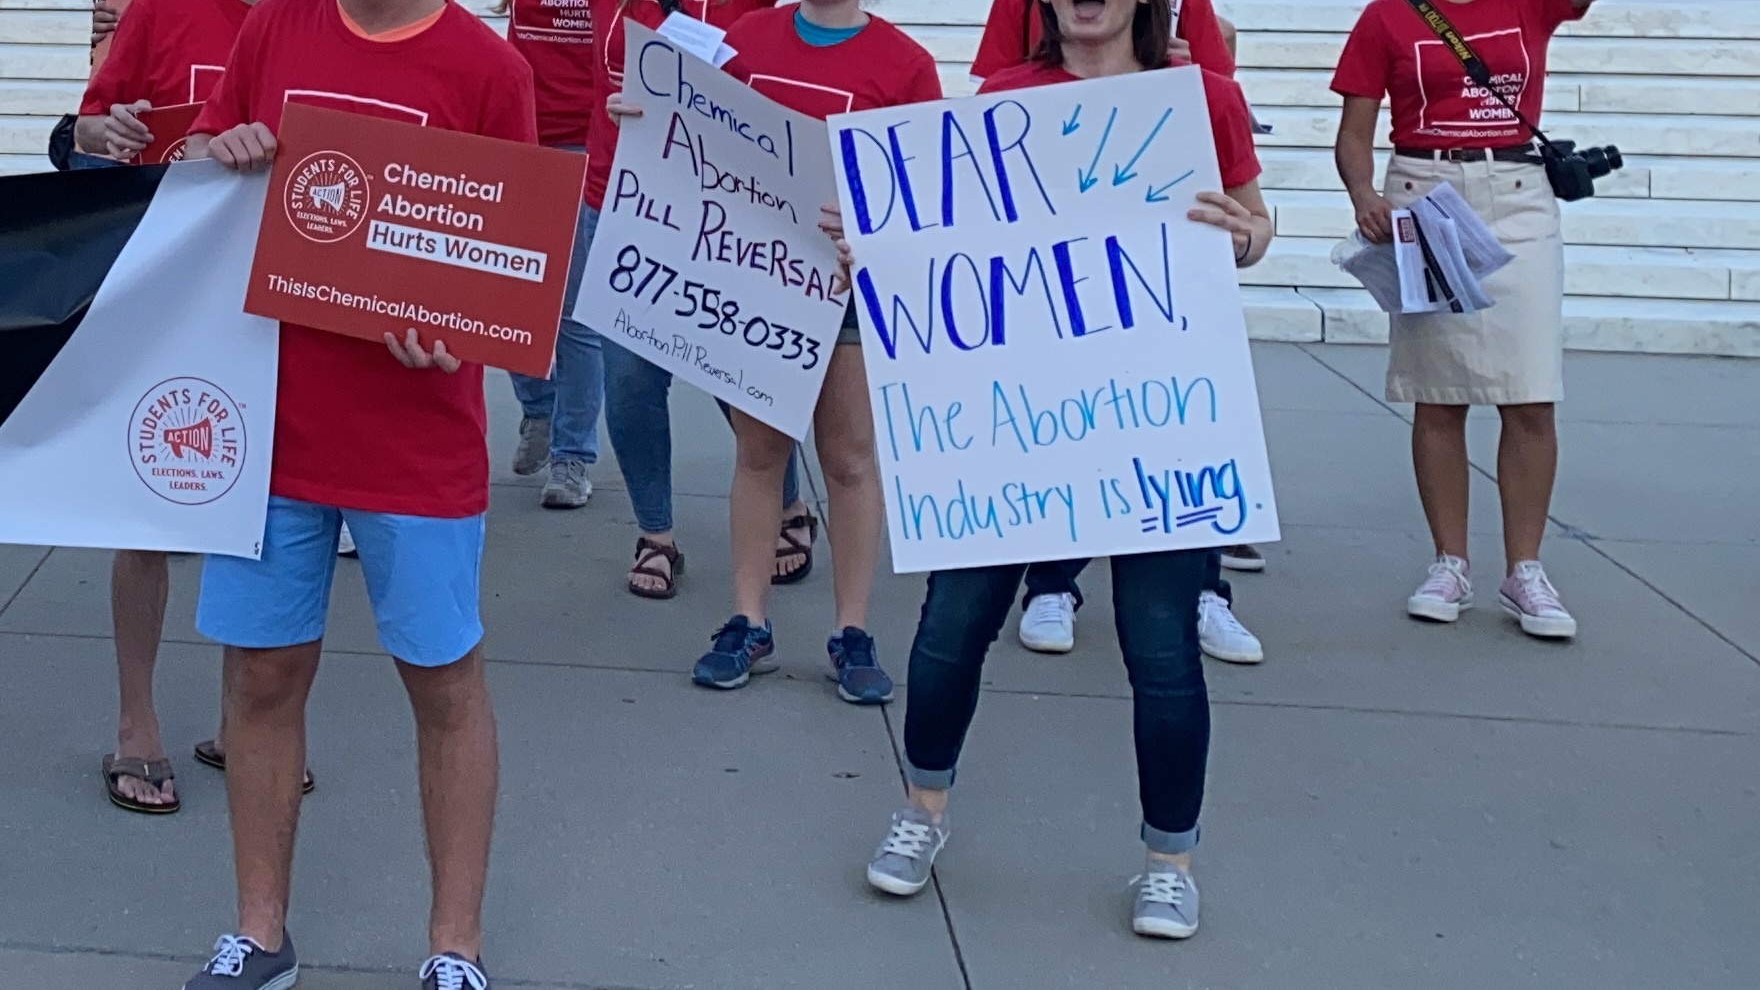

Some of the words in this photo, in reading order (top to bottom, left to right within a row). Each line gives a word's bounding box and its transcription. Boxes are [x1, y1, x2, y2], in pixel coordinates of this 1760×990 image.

[552, 17, 593, 29] WOMEN
[1463, 73, 1524, 87] CMICAL
[639, 40, 794, 177] Chemical
[291, 159, 336, 210] STUDENTS
[337, 162, 360, 188] FOR
[383, 162, 504, 204] Chemical
[662, 112, 798, 225] Abortion
[839, 99, 1057, 235] DEAR
[312, 187, 342, 206] ACTION
[345, 190, 363, 220] LIFE
[377, 193, 484, 232] Abortion
[612, 168, 682, 232] PILL
[372, 223, 437, 254] Hurts
[445, 237, 541, 276] Women
[267, 274, 533, 346] ThisIsChemicalAbortion.com
[609, 244, 821, 371] 877-558-0333
[856, 222, 1188, 360] WOMEN,
[139, 388, 191, 464] STUDENTS
[197, 391, 229, 423] FOR
[220, 426, 238, 468] LIFE
[167, 426, 210, 452] ACTION
[878, 382, 974, 462] The
[991, 375, 1217, 453] Abortion
[151, 467, 199, 479] ELECTIONS.
[200, 470, 226, 480] LAWS.
[169, 480, 208, 492] LEADERS.
[895, 475, 1078, 542] Industry
[1099, 468, 1132, 520] is
